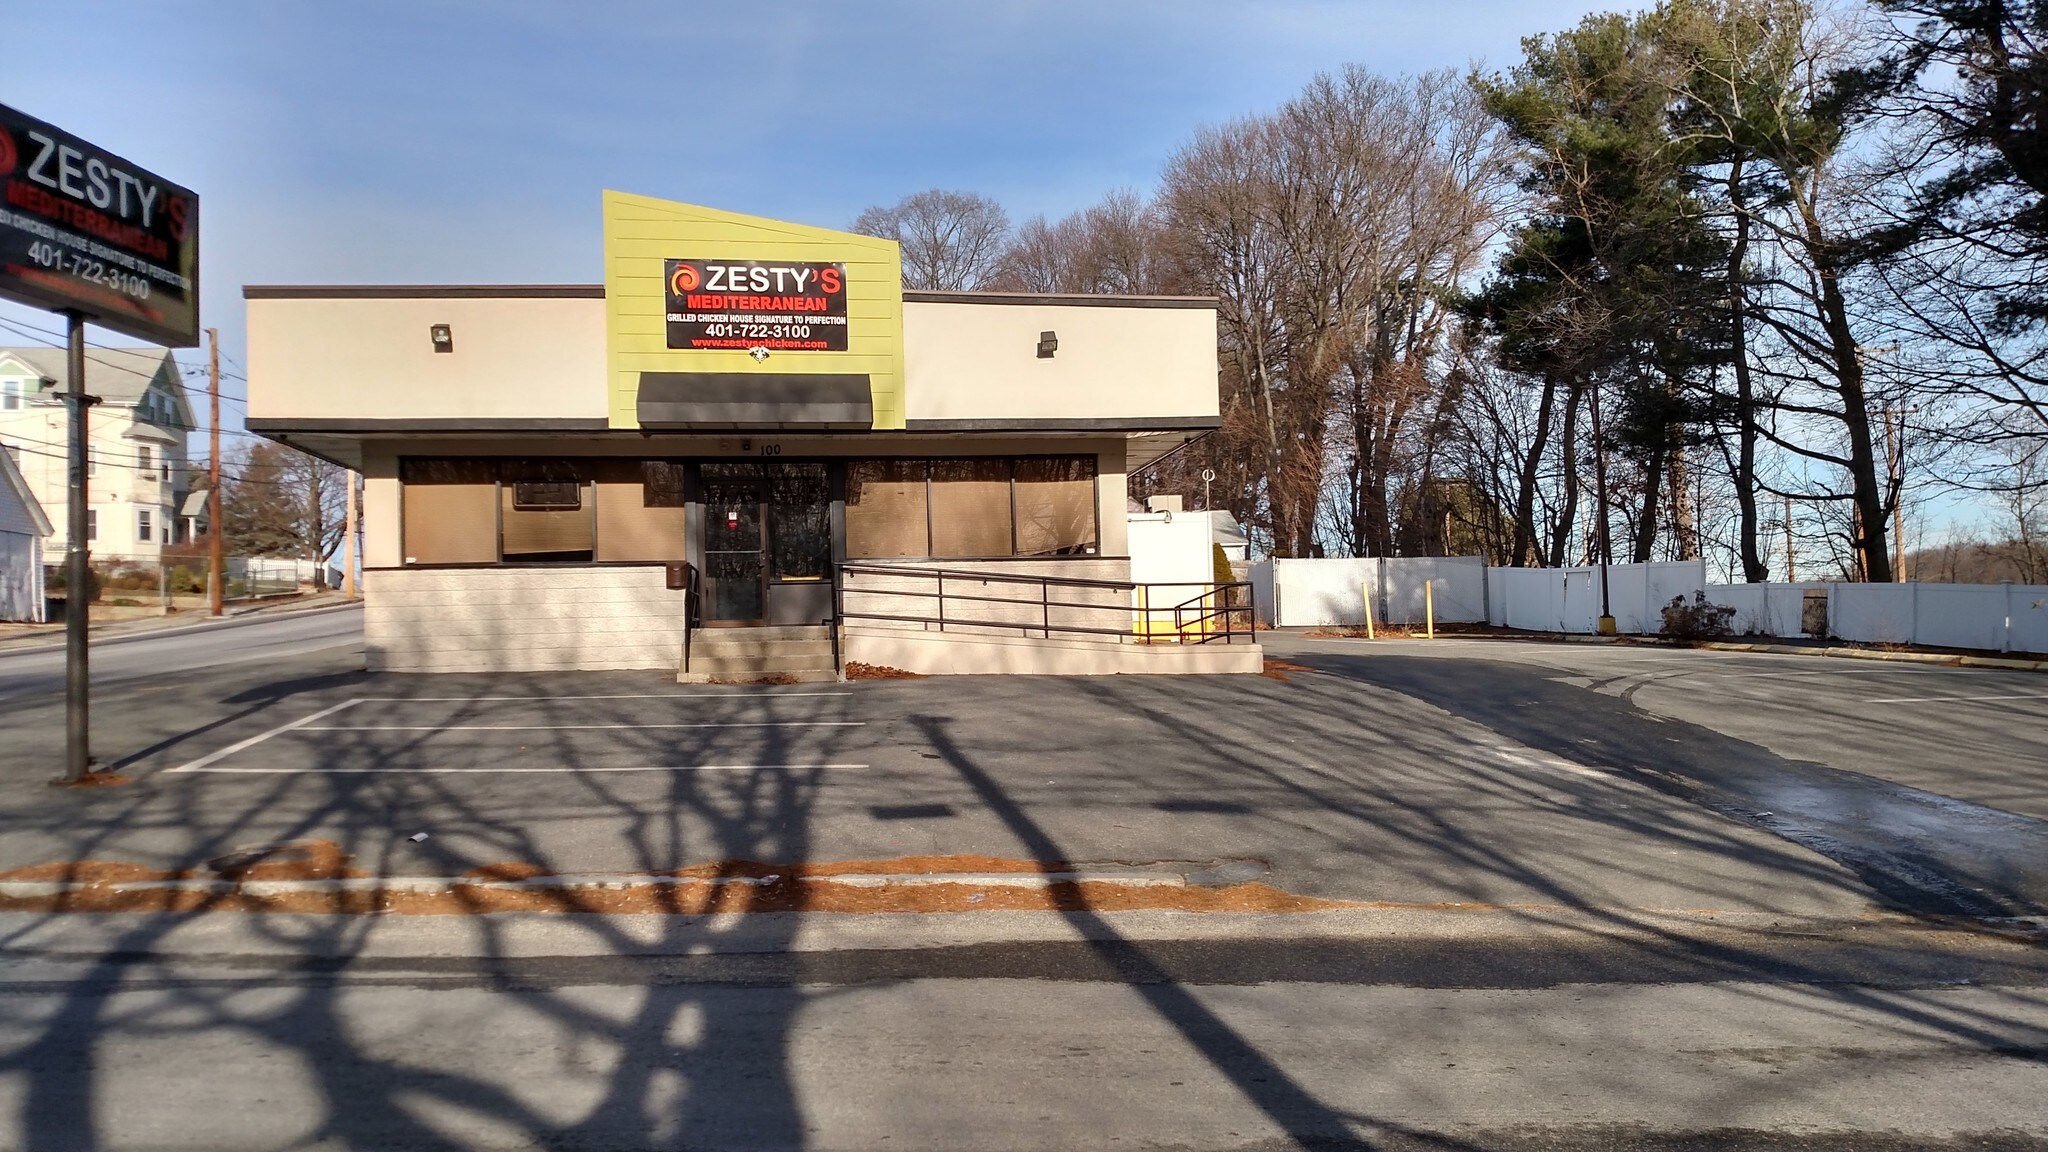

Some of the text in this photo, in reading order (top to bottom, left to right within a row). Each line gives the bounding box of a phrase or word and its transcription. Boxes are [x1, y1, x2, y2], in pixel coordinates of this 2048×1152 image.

[27, 130, 190, 242] ZESTY'S
[6, 178, 169, 261] MEDITERRANEAN
[56, 227, 87, 252] HOUSE
[136, 258, 146, 273] TO
[28, 241, 150, 300] 401-722-3100
[705, 265, 841, 294] ZESTY'S
[687, 294, 827, 311] MEDITERRANEAN
[667, 313, 846, 325] GRILLED CHICKEN HOUSE SIGNATURE TO PERFECTION
[705, 324, 811, 338] 401-722-3100
[691, 339, 828, 349] www.zestyschicken.com
[760, 444, 781, 456] 100
